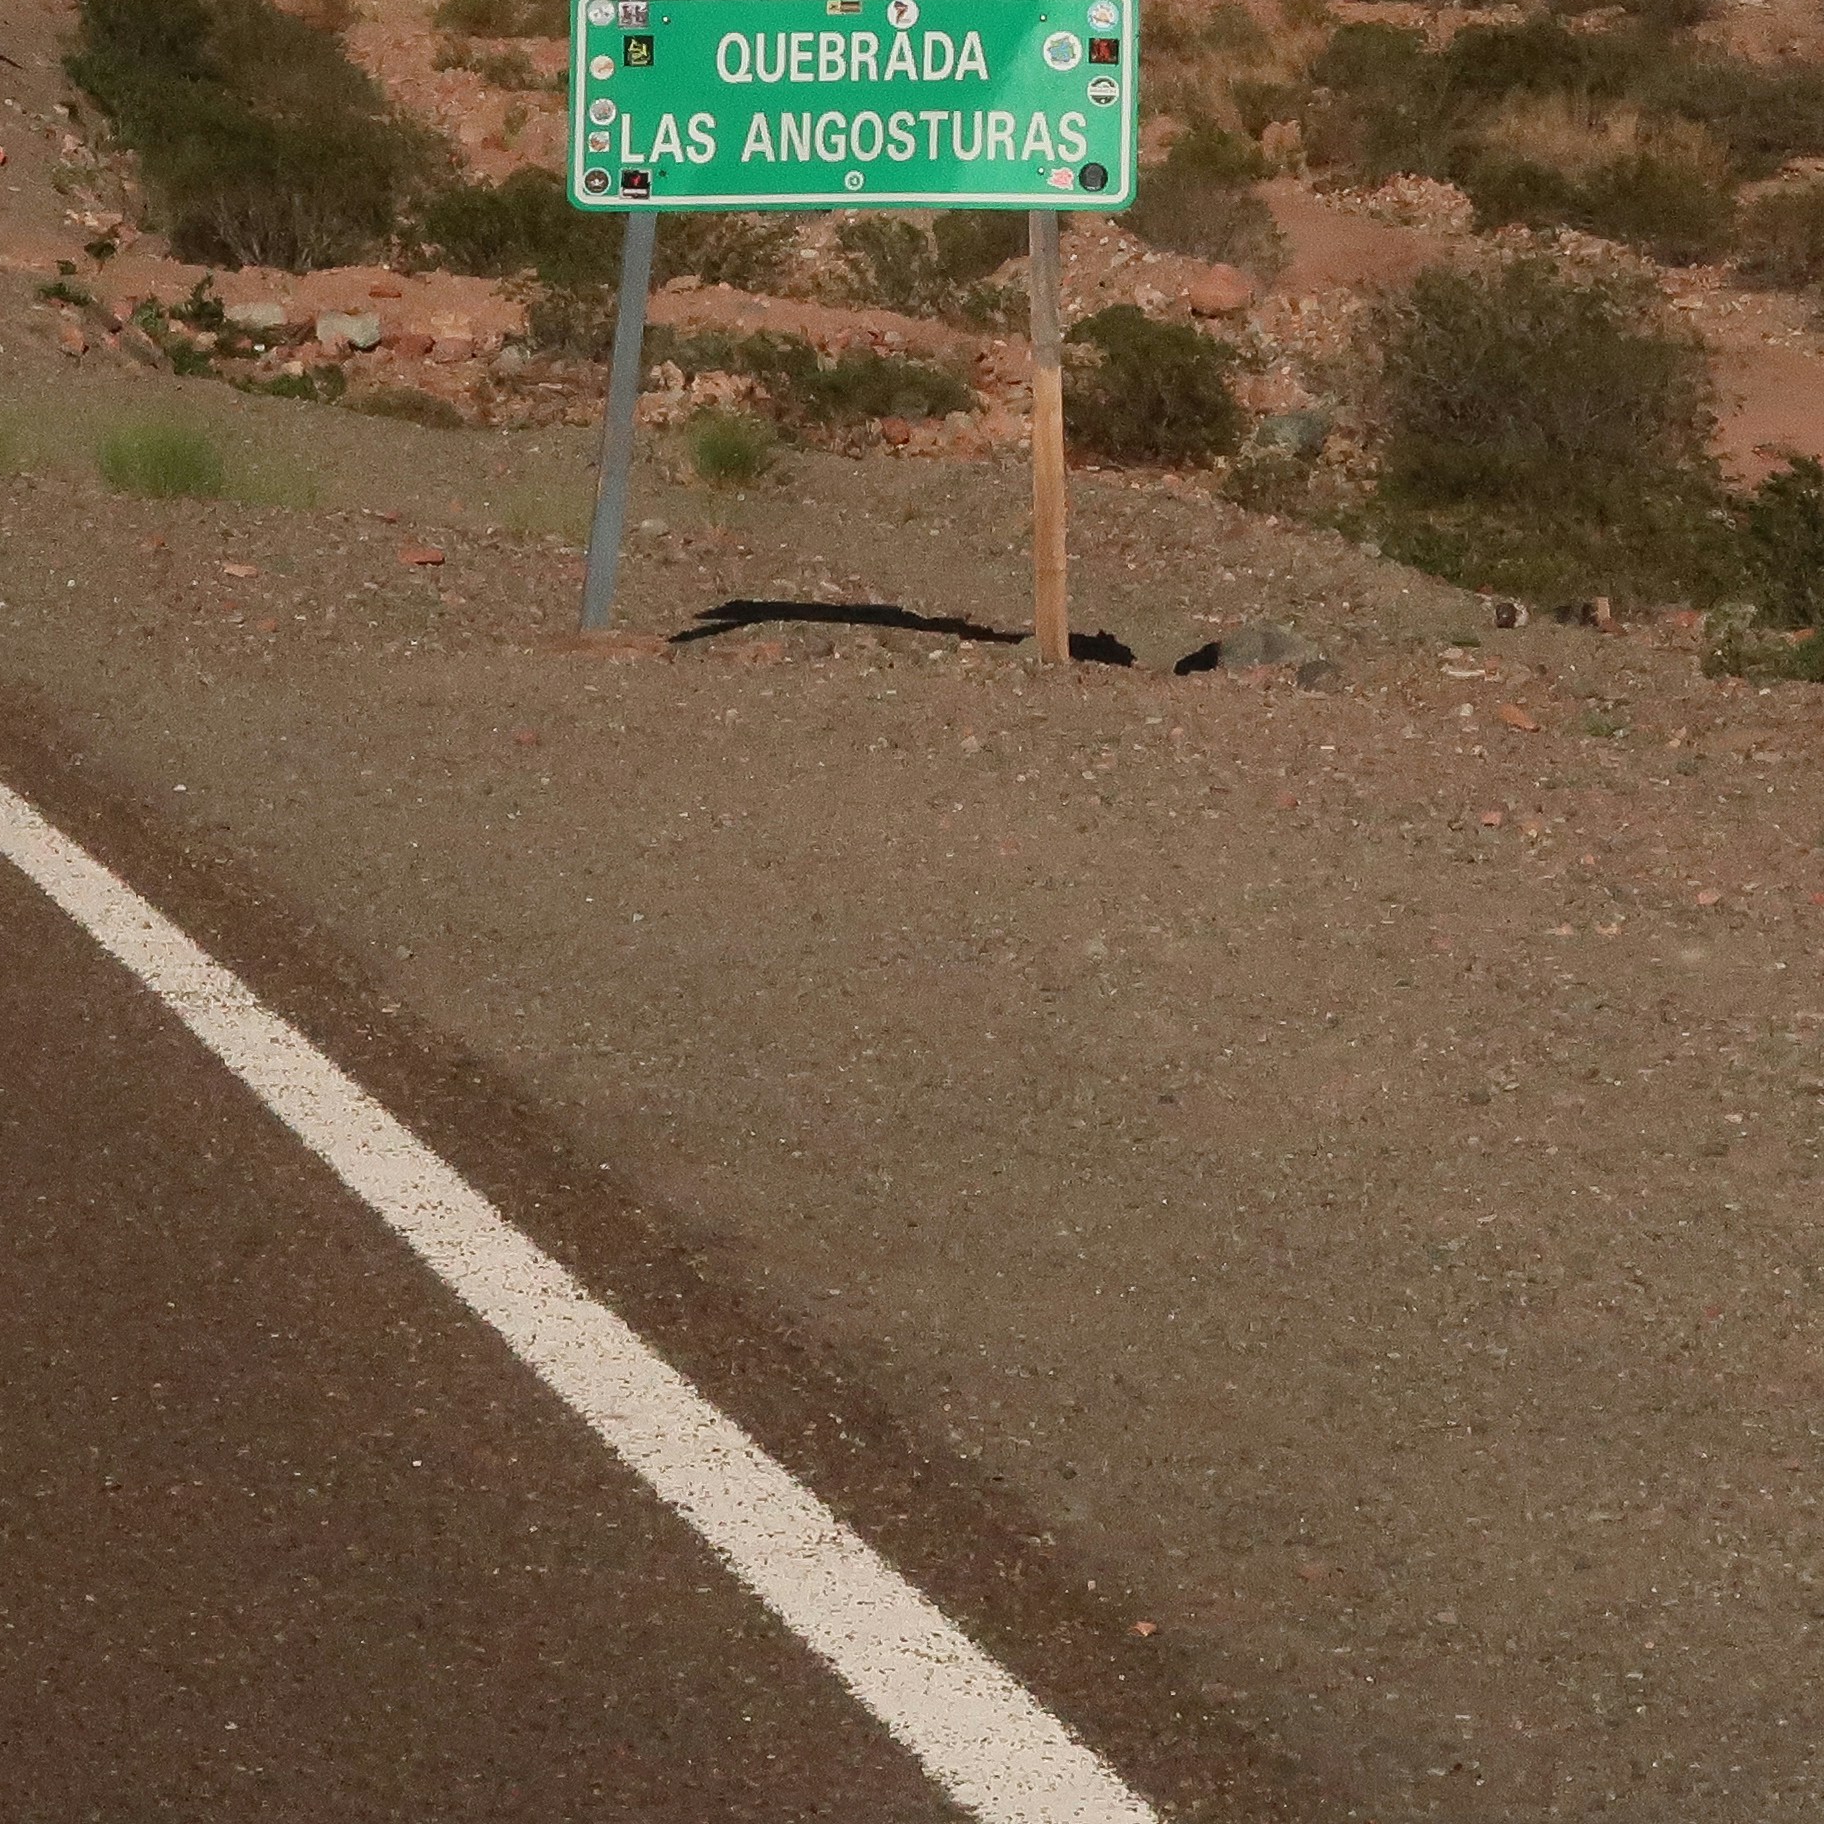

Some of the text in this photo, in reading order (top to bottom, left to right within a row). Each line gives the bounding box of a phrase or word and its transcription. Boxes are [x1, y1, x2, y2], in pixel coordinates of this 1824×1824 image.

[716, 31, 988, 83] QUEBRADA
[620, 110, 1088, 163] LAS ANGOSTURAS
